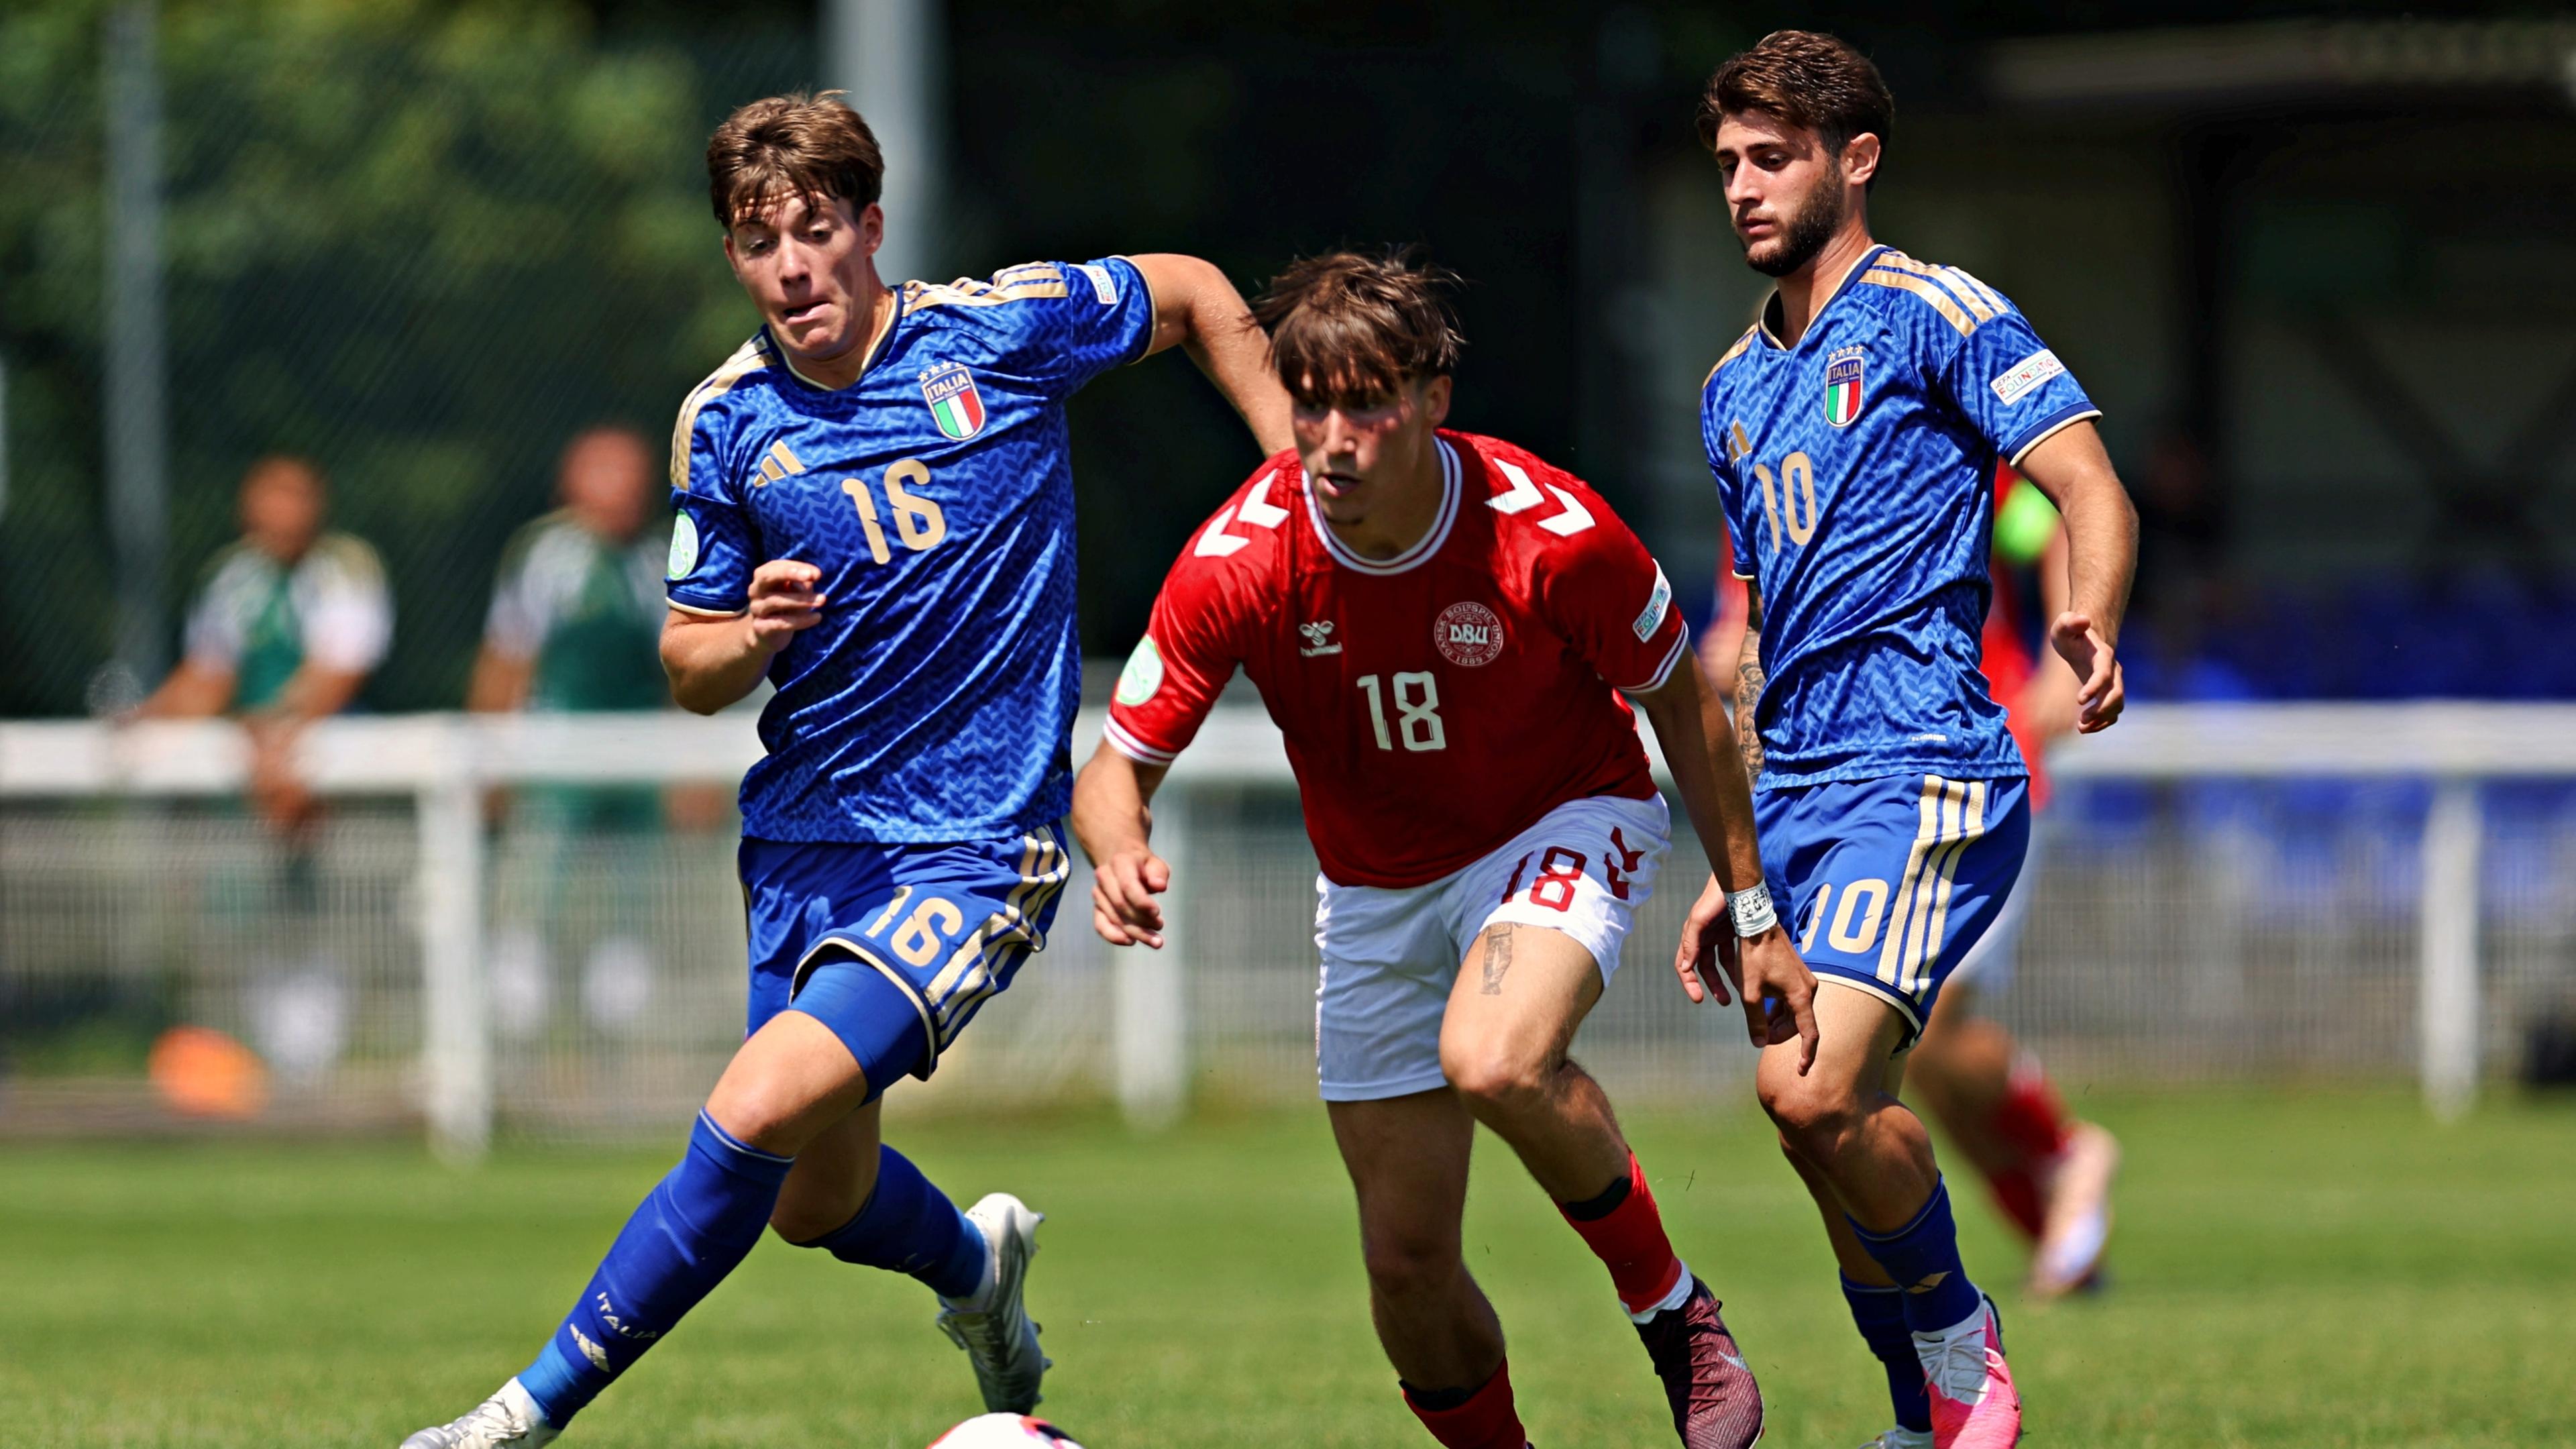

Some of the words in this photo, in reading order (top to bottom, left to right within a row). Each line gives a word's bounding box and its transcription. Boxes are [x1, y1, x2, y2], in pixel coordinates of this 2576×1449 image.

[927, 374, 968, 399] ITALIA
[1829, 362, 1860, 380] ITALIA
[841, 458, 947, 564] 16
[1754, 451, 1817, 553] 10
[1437, 619, 1453, 656] DANSK
[1485, 625, 1501, 659] UNION
[1449, 624, 1489, 645] DBU
[1456, 656, 1483, 665] 1889
[1356, 671, 1446, 751] 18
[1501, 846, 1588, 912] 18
[865, 885, 963, 967] 16
[1801, 877, 1889, 954] 10
[596, 1291, 657, 1338] ITALIA
